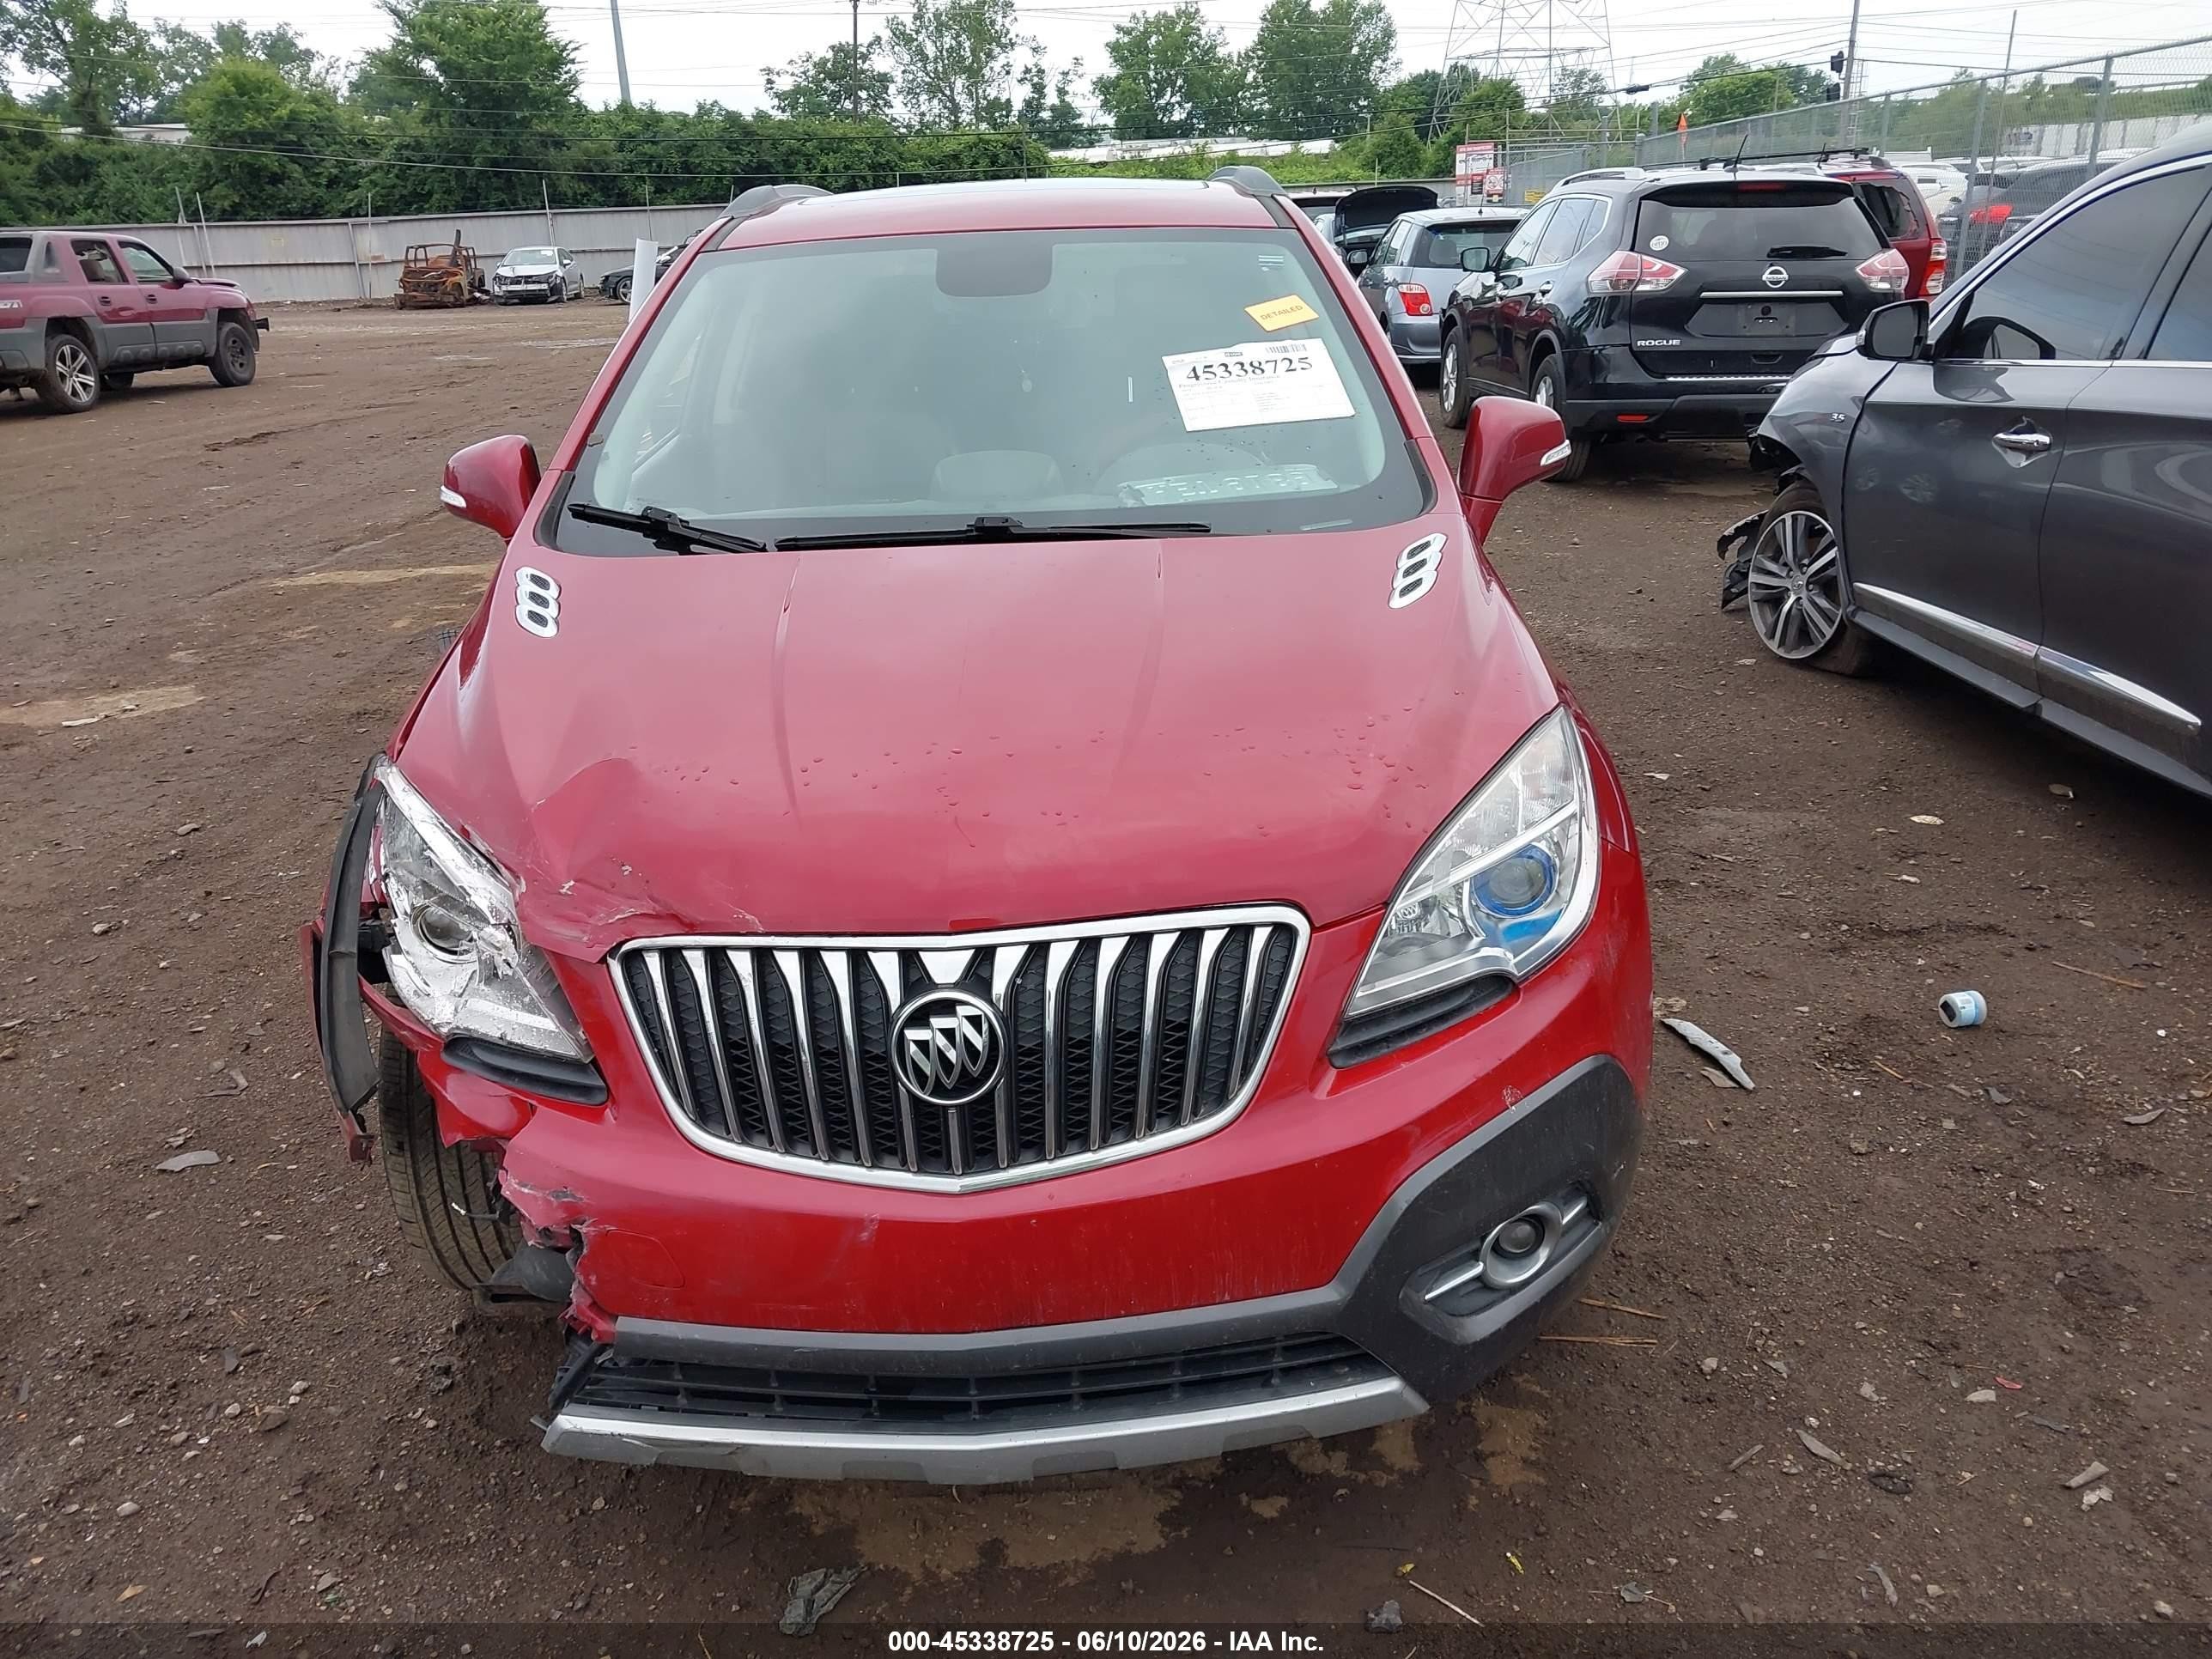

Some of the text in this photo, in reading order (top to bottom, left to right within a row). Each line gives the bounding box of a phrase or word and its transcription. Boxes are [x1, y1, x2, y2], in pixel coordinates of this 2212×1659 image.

[1260, 305, 1304, 320] DETAILED
[1637, 337, 1681, 347] ROGUE
[1187, 356, 1314, 381] 45338725
